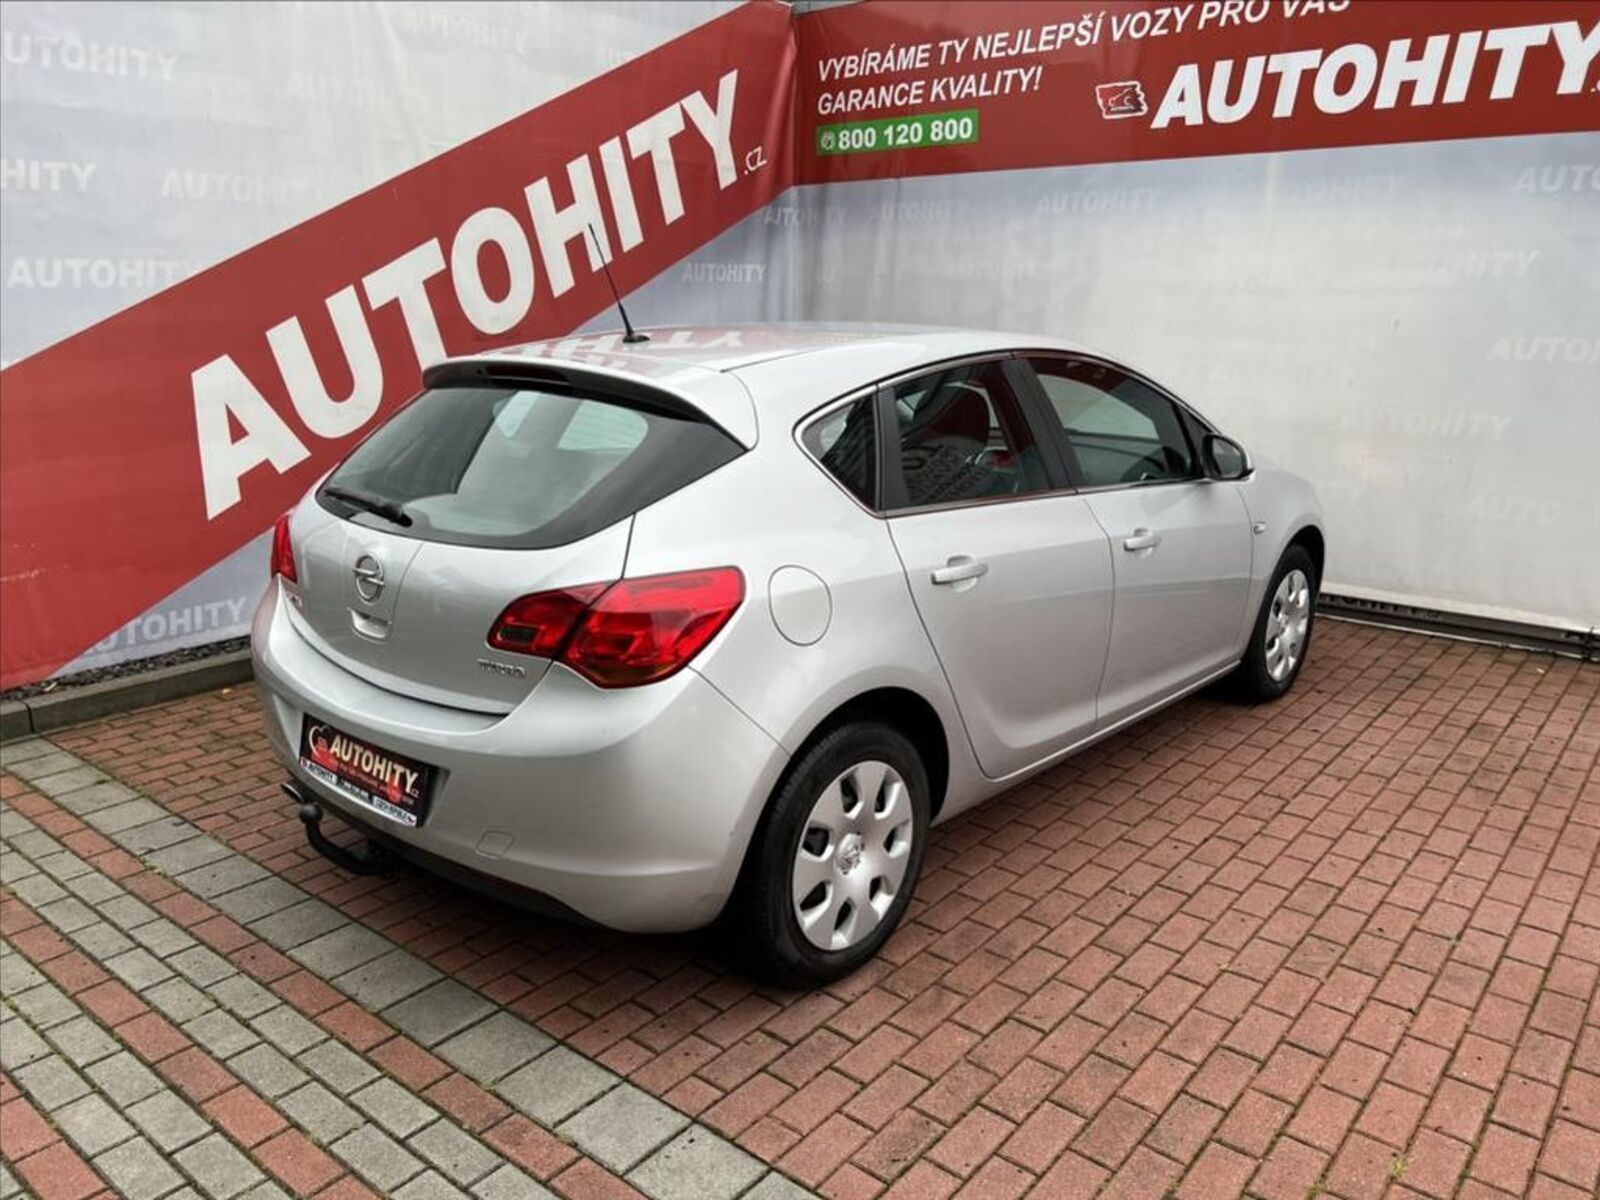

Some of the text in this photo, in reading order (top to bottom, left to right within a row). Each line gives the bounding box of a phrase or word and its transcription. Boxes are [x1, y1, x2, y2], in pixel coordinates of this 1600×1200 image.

[3, 30, 178, 81] UTOHITY
[818, 43, 931, 82] VYBÍRÁME
[938, 38, 970, 66] TY
[973, 11, 1106, 59] NEJLEPŠÍ
[1110, 4, 1195, 42] VOZY
[1197, 0, 1271, 31] PRO
[817, 66, 1043, 116] GARANCE KVALITY!
[838, 118, 973, 151] 800 120 800
[682, 263, 767, 284] AUTOHITY
[330, 734, 419, 794] AUTOHITY
